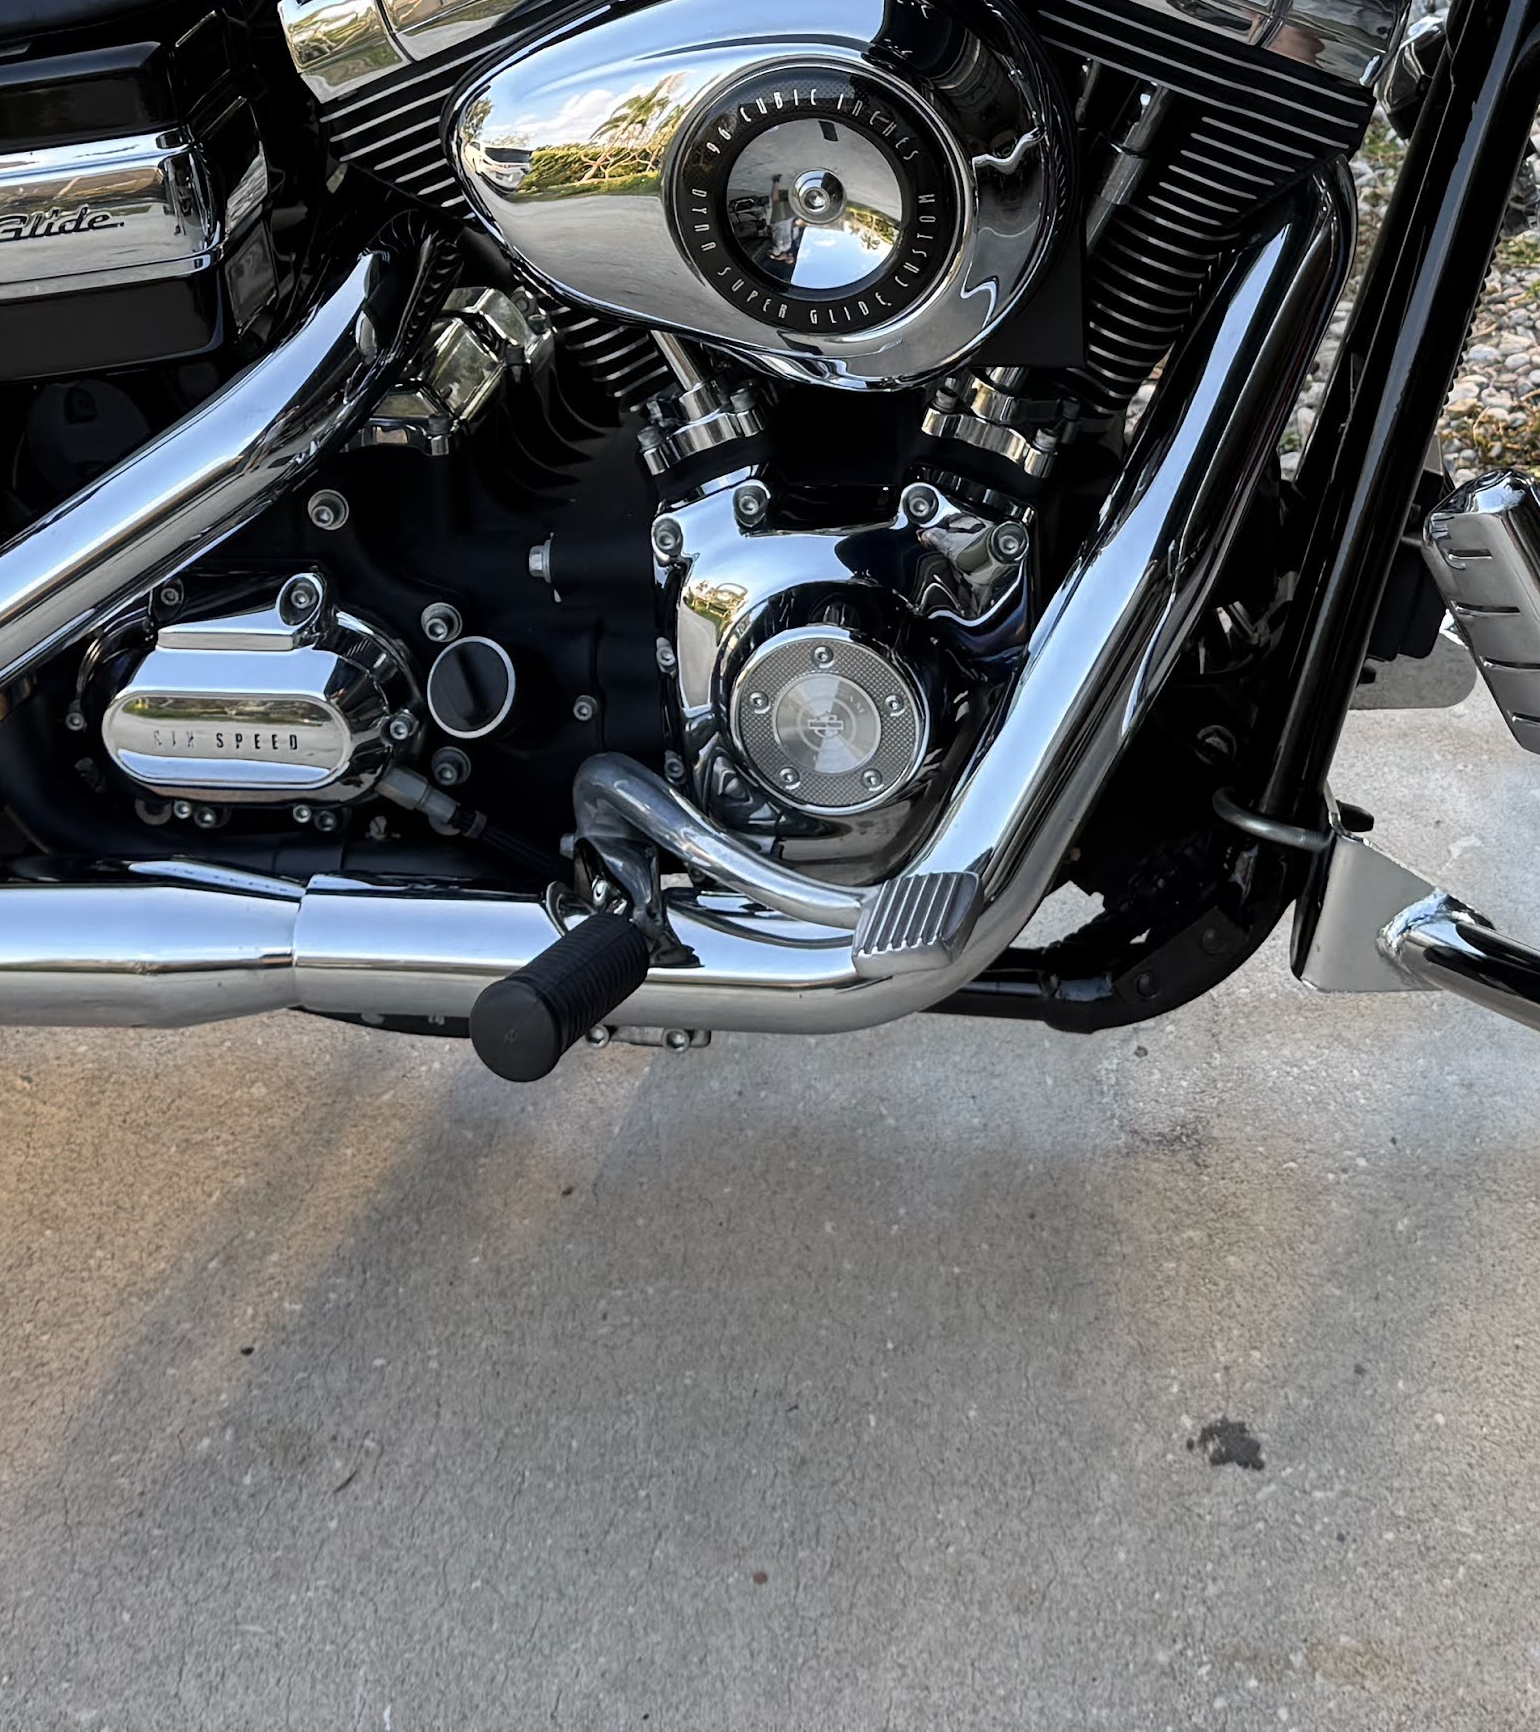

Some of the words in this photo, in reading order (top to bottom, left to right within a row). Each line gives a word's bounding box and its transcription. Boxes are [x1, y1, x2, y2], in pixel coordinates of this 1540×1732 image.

[705, 126, 733, 155] 96
[739, 88, 818, 123] CUBIC
[836, 92, 919, 161] INCHES
[691, 187, 717, 252] DYNA
[717, 266, 788, 319] SUPER
[810, 291, 890, 324] GLIDE
[894, 193, 937, 288] CUSTOM
[215, 732, 298, 751] SPEED
